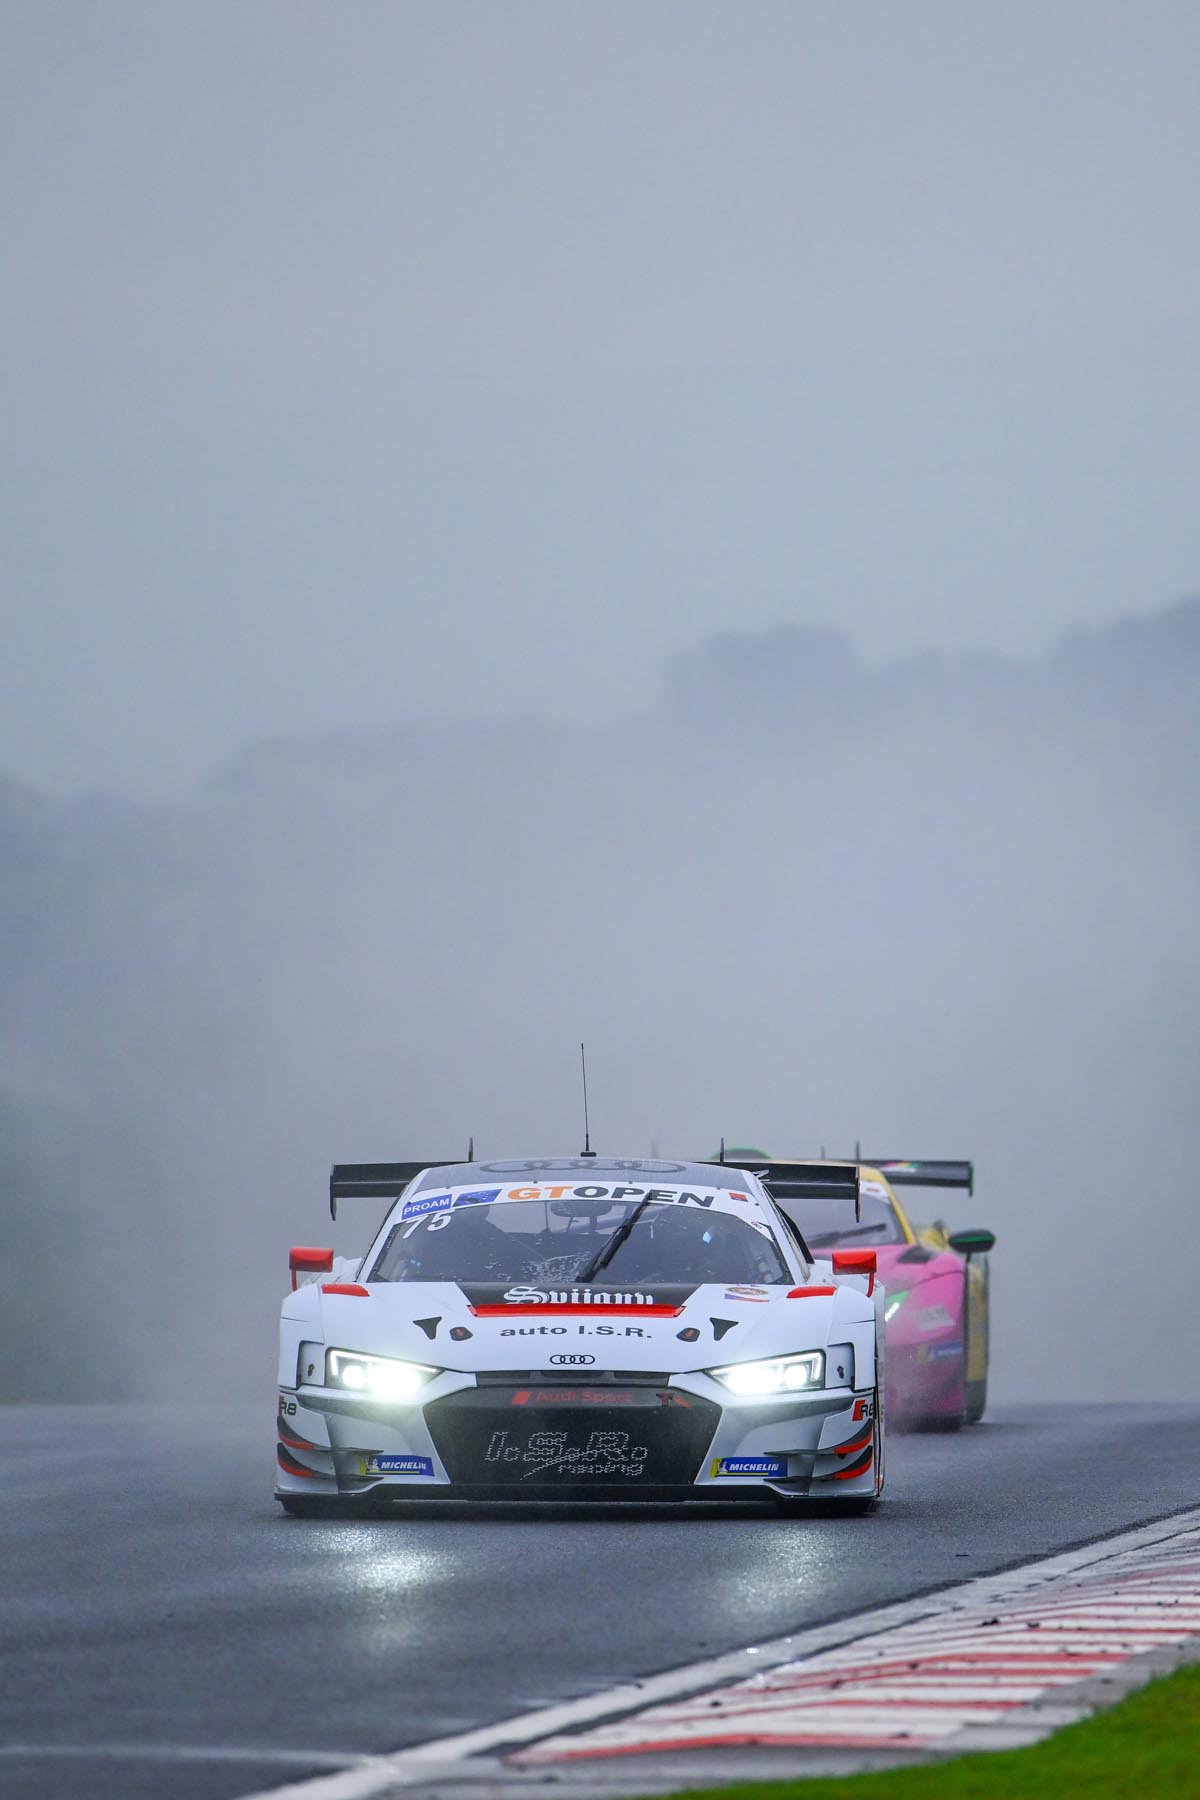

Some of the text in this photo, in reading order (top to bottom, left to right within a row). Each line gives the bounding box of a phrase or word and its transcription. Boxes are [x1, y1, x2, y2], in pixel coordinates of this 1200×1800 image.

[403, 1198, 450, 1215] PROAM
[402, 1208, 455, 1239] 75
[500, 1325, 652, 1338] auto I.S.R.
[536, 1391, 576, 1402] Audi
[380, 1461, 427, 1471] MICHELIN
[728, 1463, 779, 1472] MICHELIN
